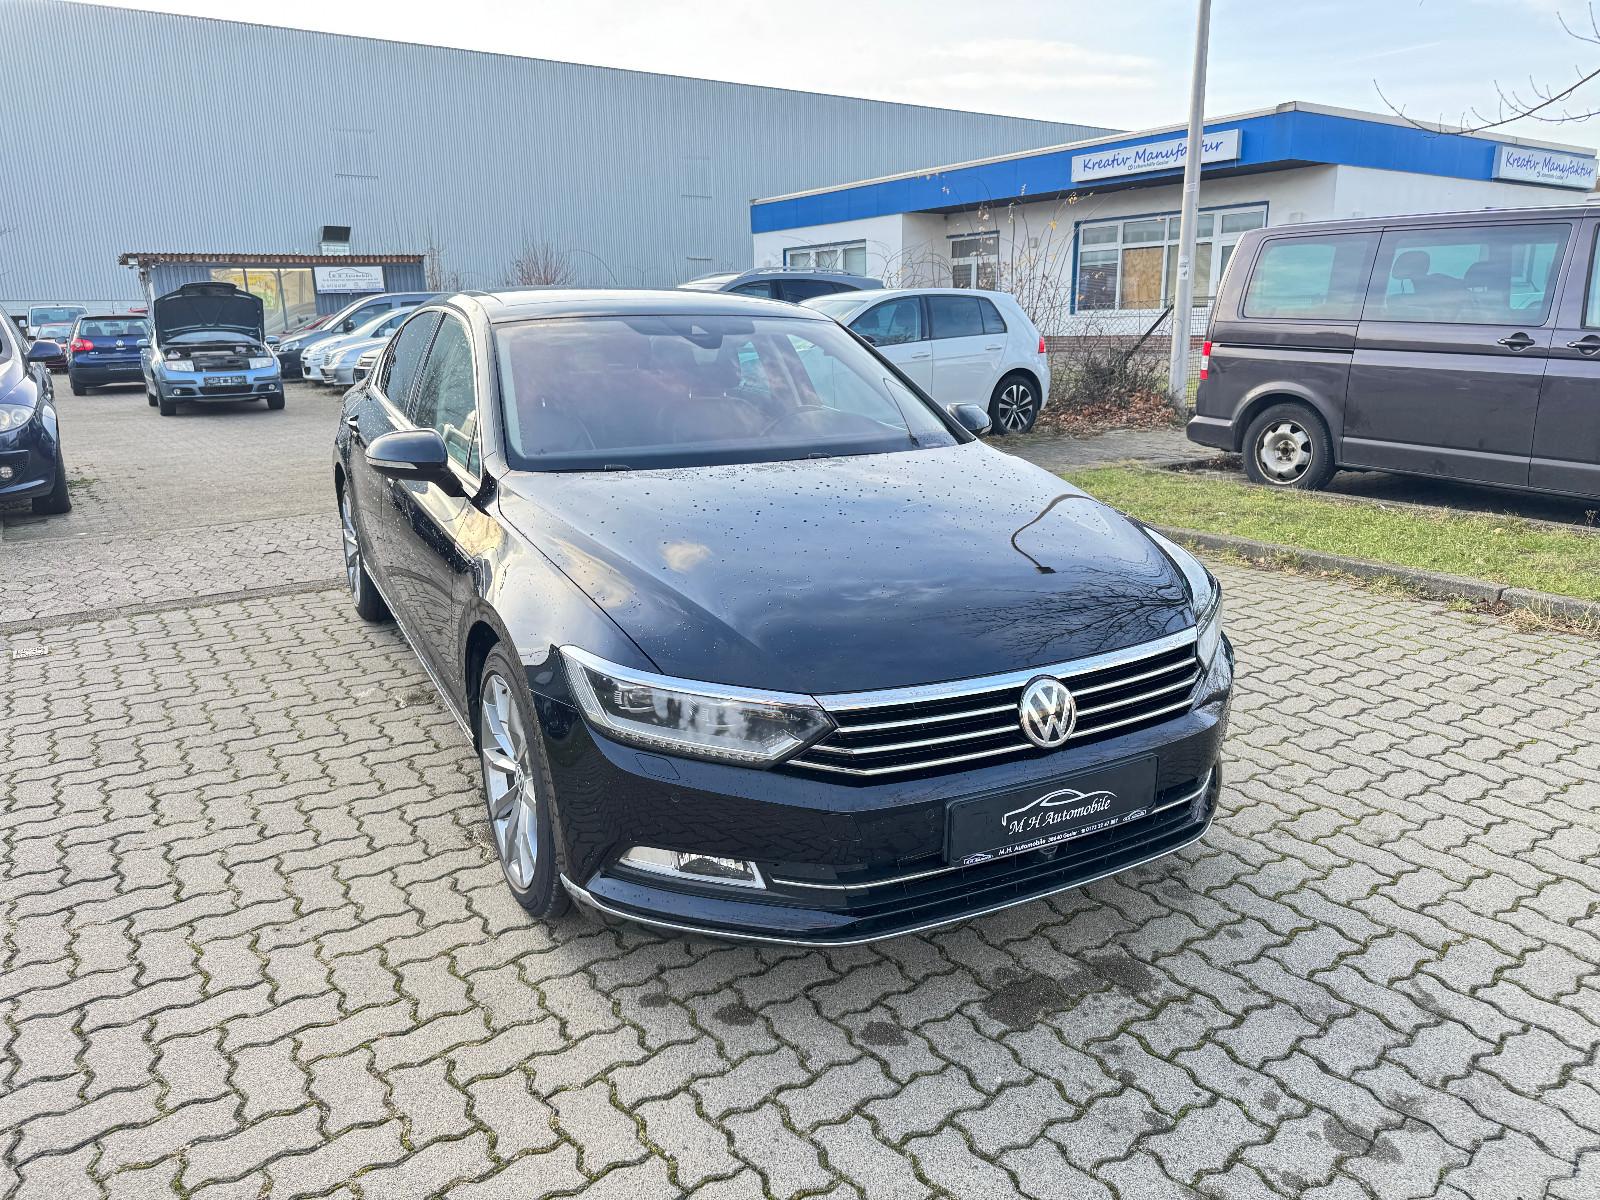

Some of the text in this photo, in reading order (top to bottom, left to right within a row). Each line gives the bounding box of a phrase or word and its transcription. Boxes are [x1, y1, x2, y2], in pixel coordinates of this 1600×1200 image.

[1083, 139, 1224, 173] Kreativ Manufatur
[1505, 151, 1594, 179] Kreativ Manufaktur
[1008, 817, 1027, 835] M
[1027, 812, 1043, 831] H
[1042, 795, 1111, 827] Automobile
[1013, 838, 1046, 852] Automobile
